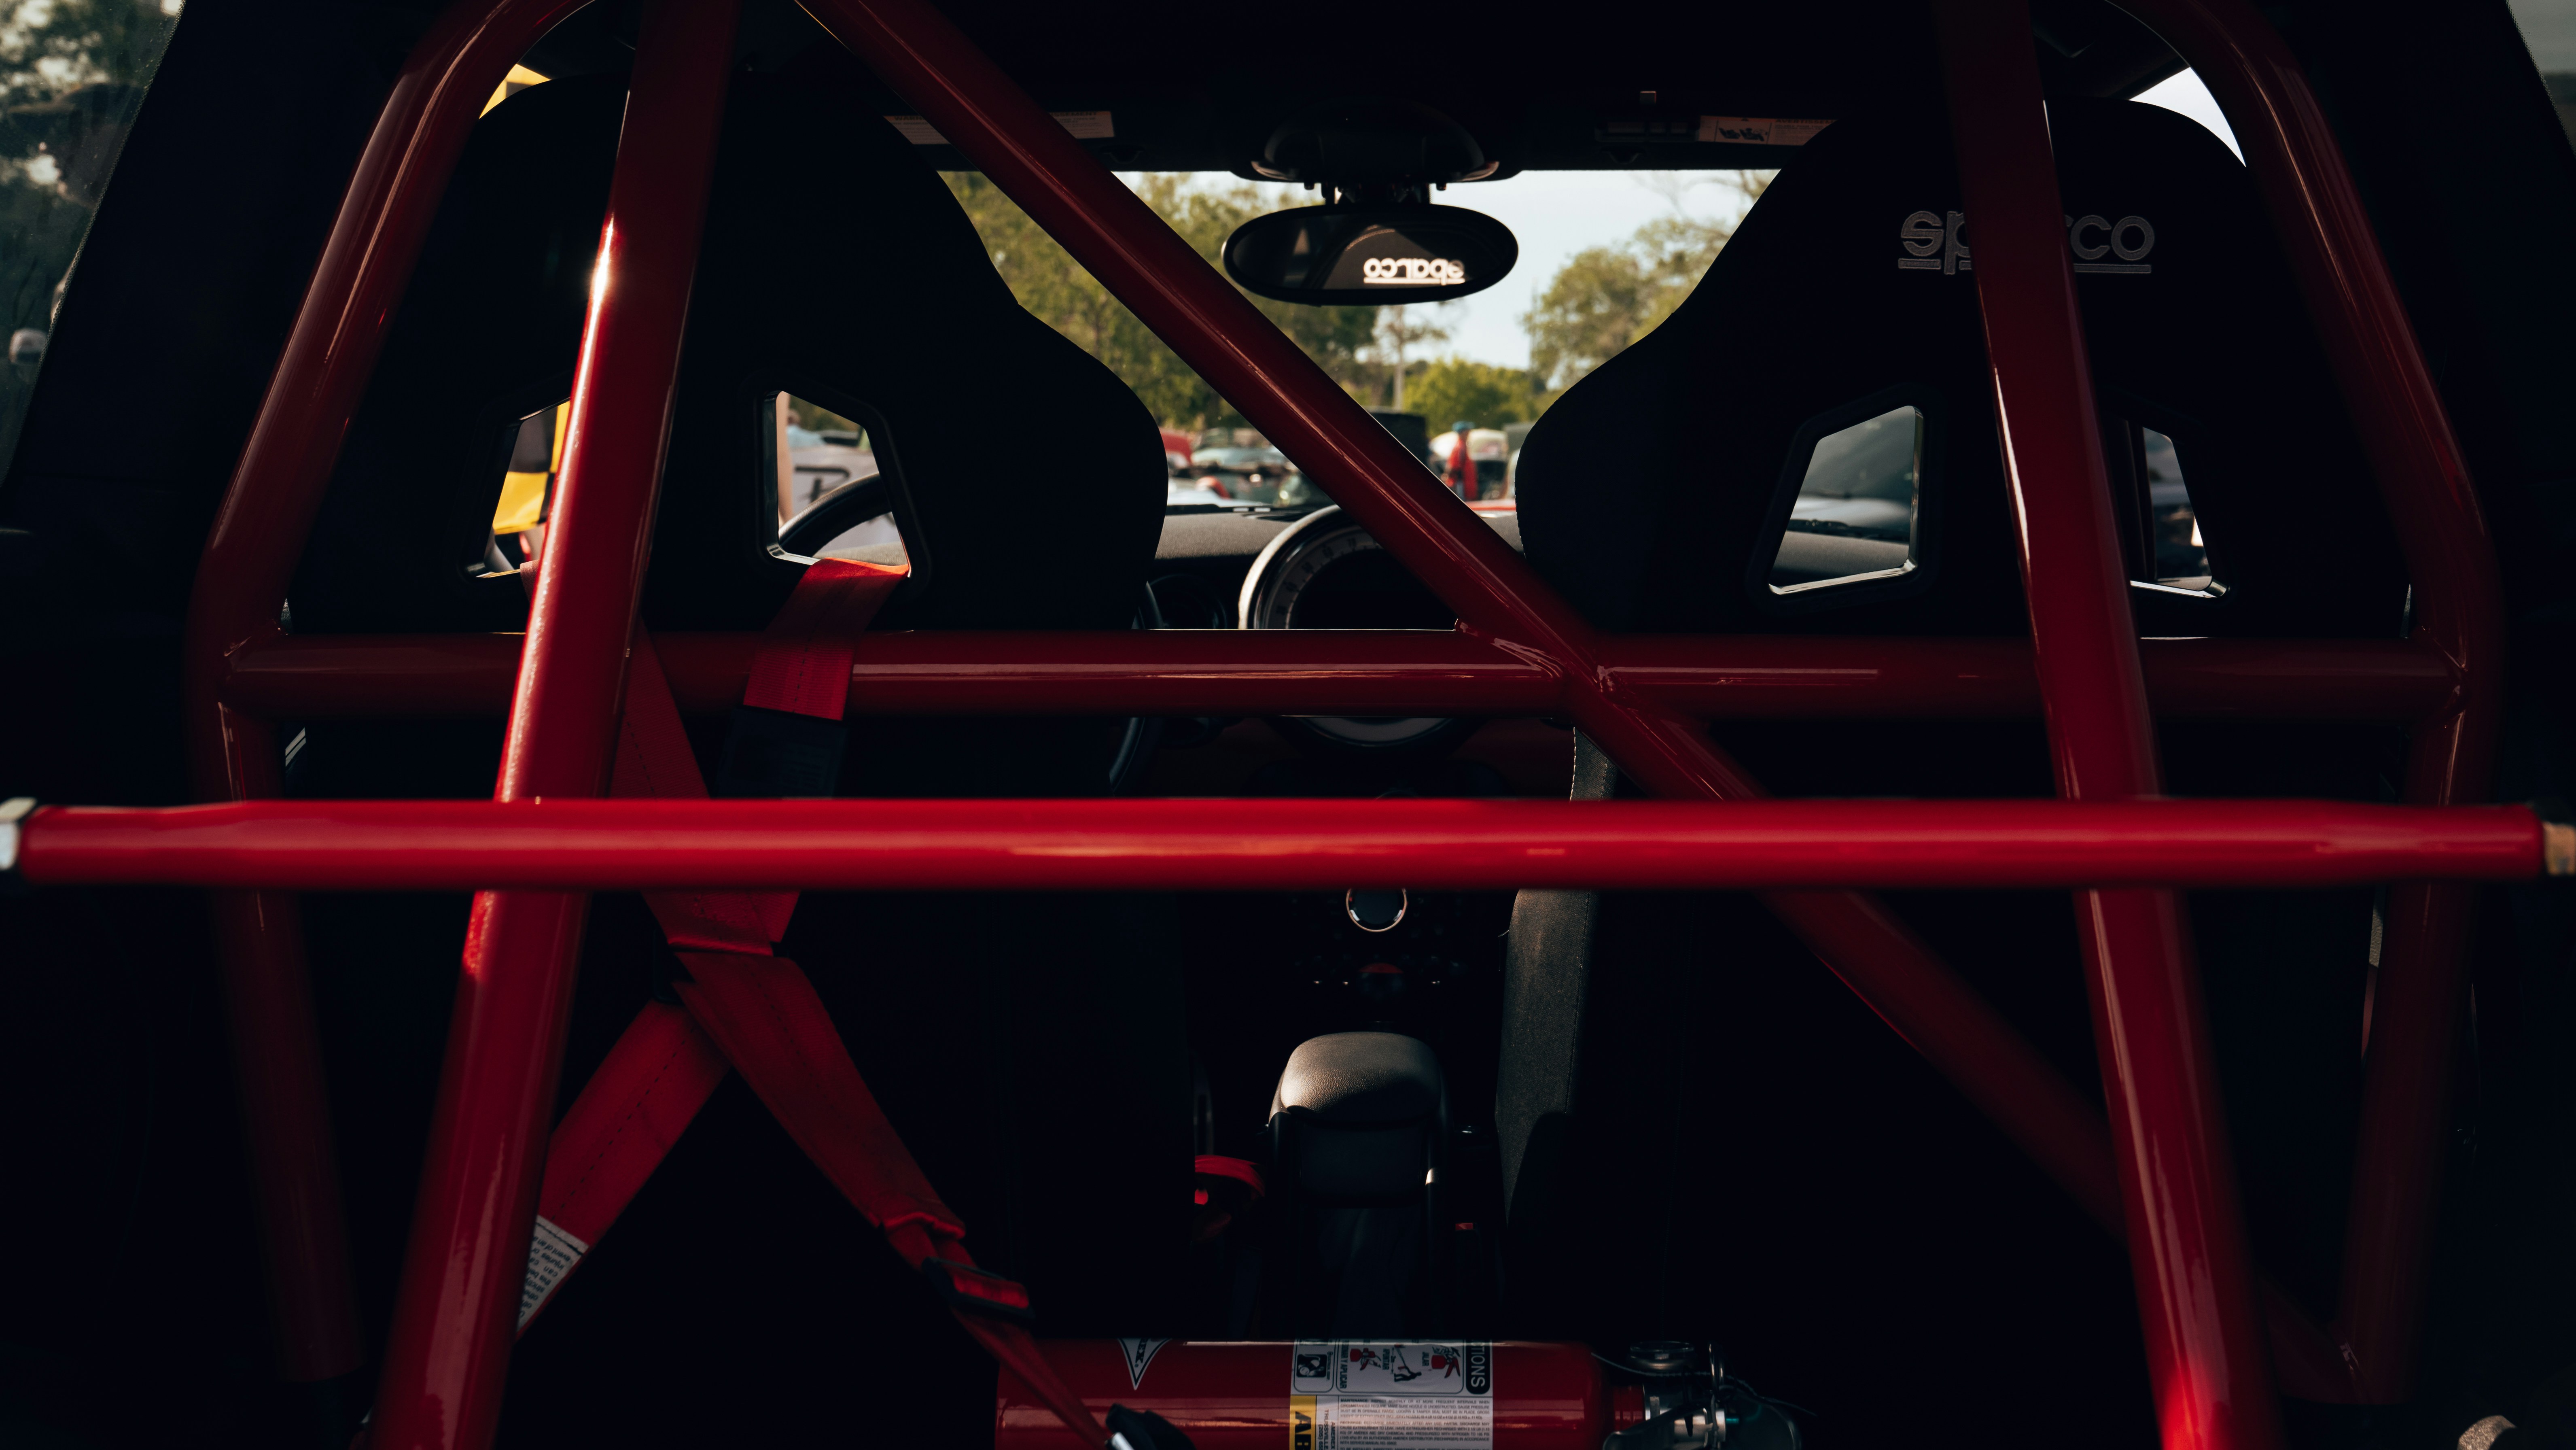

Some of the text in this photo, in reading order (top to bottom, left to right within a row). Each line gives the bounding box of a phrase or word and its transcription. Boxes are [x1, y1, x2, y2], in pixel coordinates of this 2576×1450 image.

[1898, 210, 2156, 275] spco
[1339, 1363, 1348, 1389] APLICAR
[1470, 1345, 1485, 1388] TIONS
